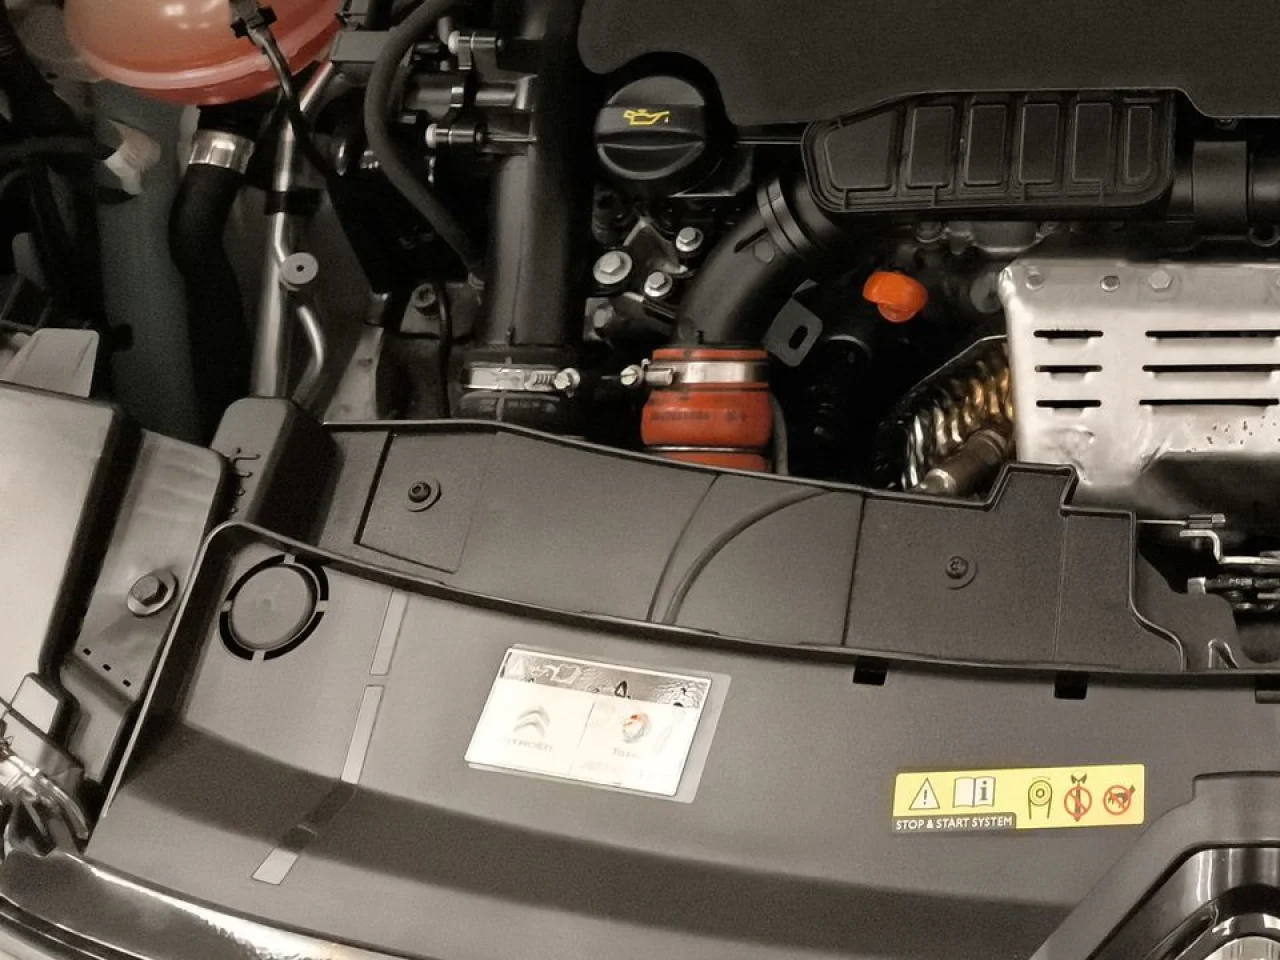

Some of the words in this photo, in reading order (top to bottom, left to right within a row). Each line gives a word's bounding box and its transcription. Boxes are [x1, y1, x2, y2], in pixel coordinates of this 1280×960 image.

[612, 747, 640, 759] TOTA
[895, 819, 925, 830] STOP
[926, 819, 934, 829] &
[936, 816, 970, 829] START
[971, 814, 1013, 827] SYSTEM
